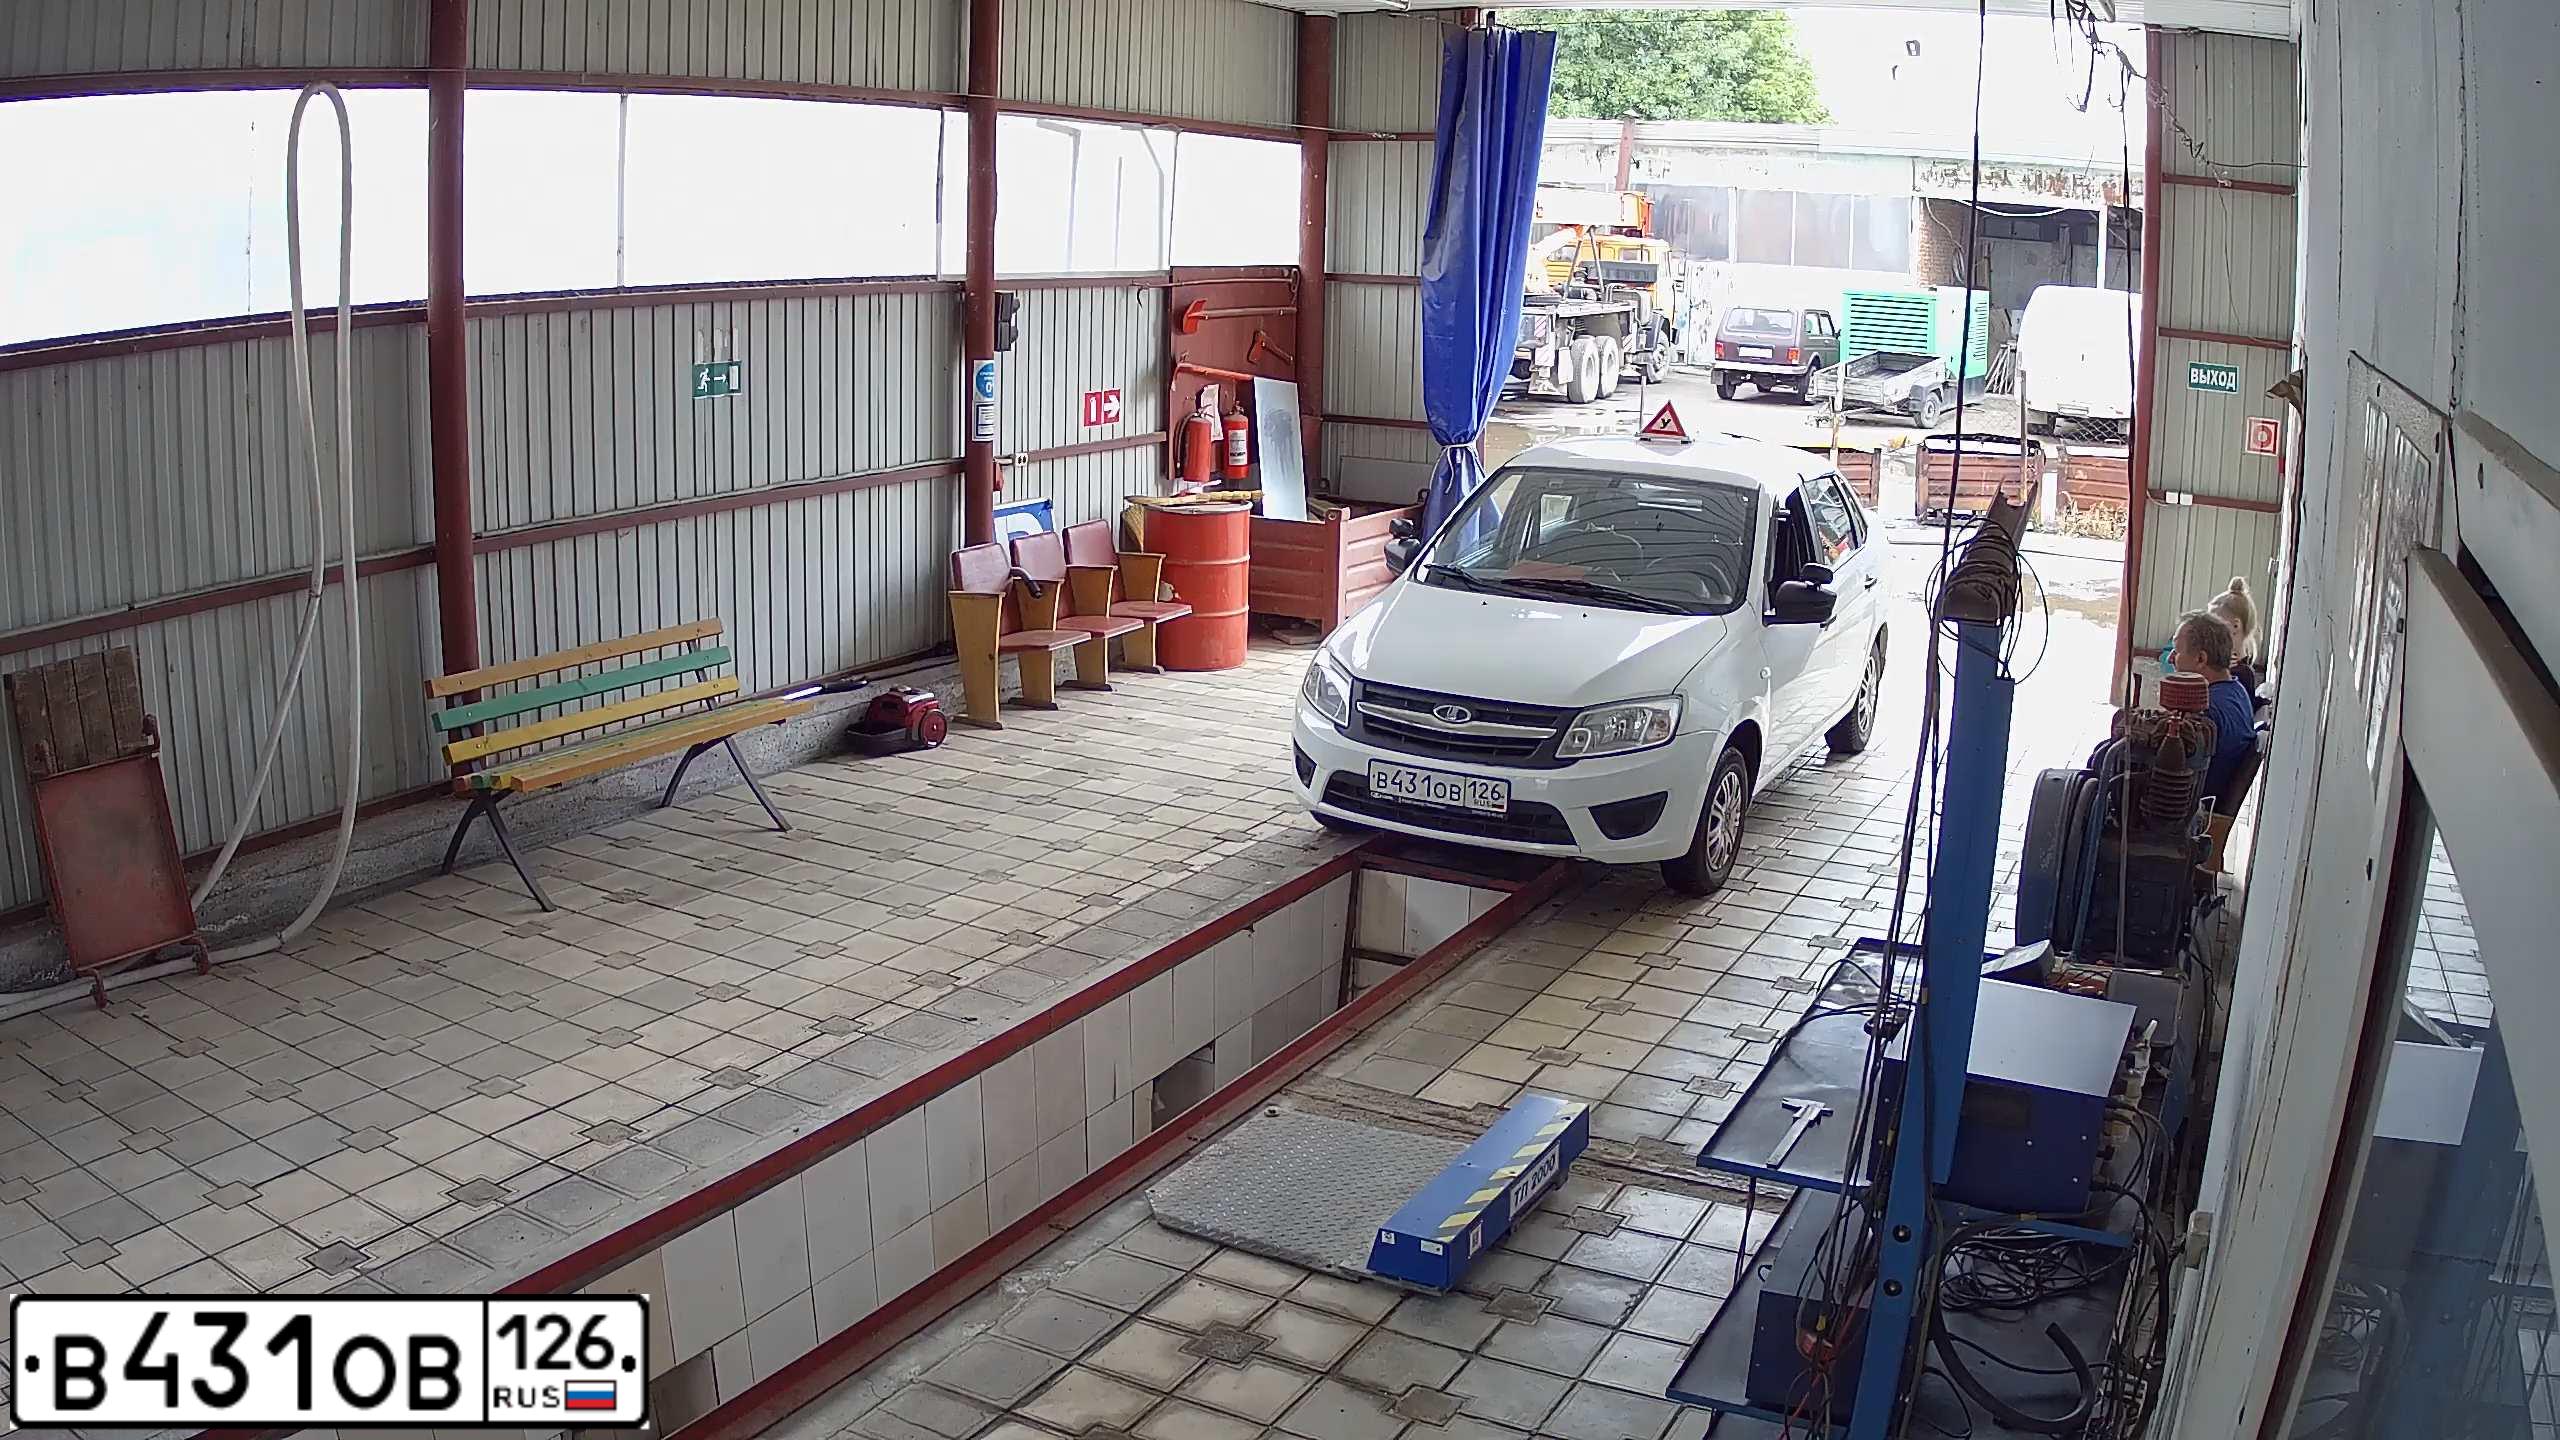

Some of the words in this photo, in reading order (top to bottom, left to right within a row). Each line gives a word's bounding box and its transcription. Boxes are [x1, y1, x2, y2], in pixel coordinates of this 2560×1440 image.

[2190, 367, 2236, 391] ВЫХОД
[1467, 780, 1502, 801] 126
[1531, 1153, 1556, 1191] 2000
